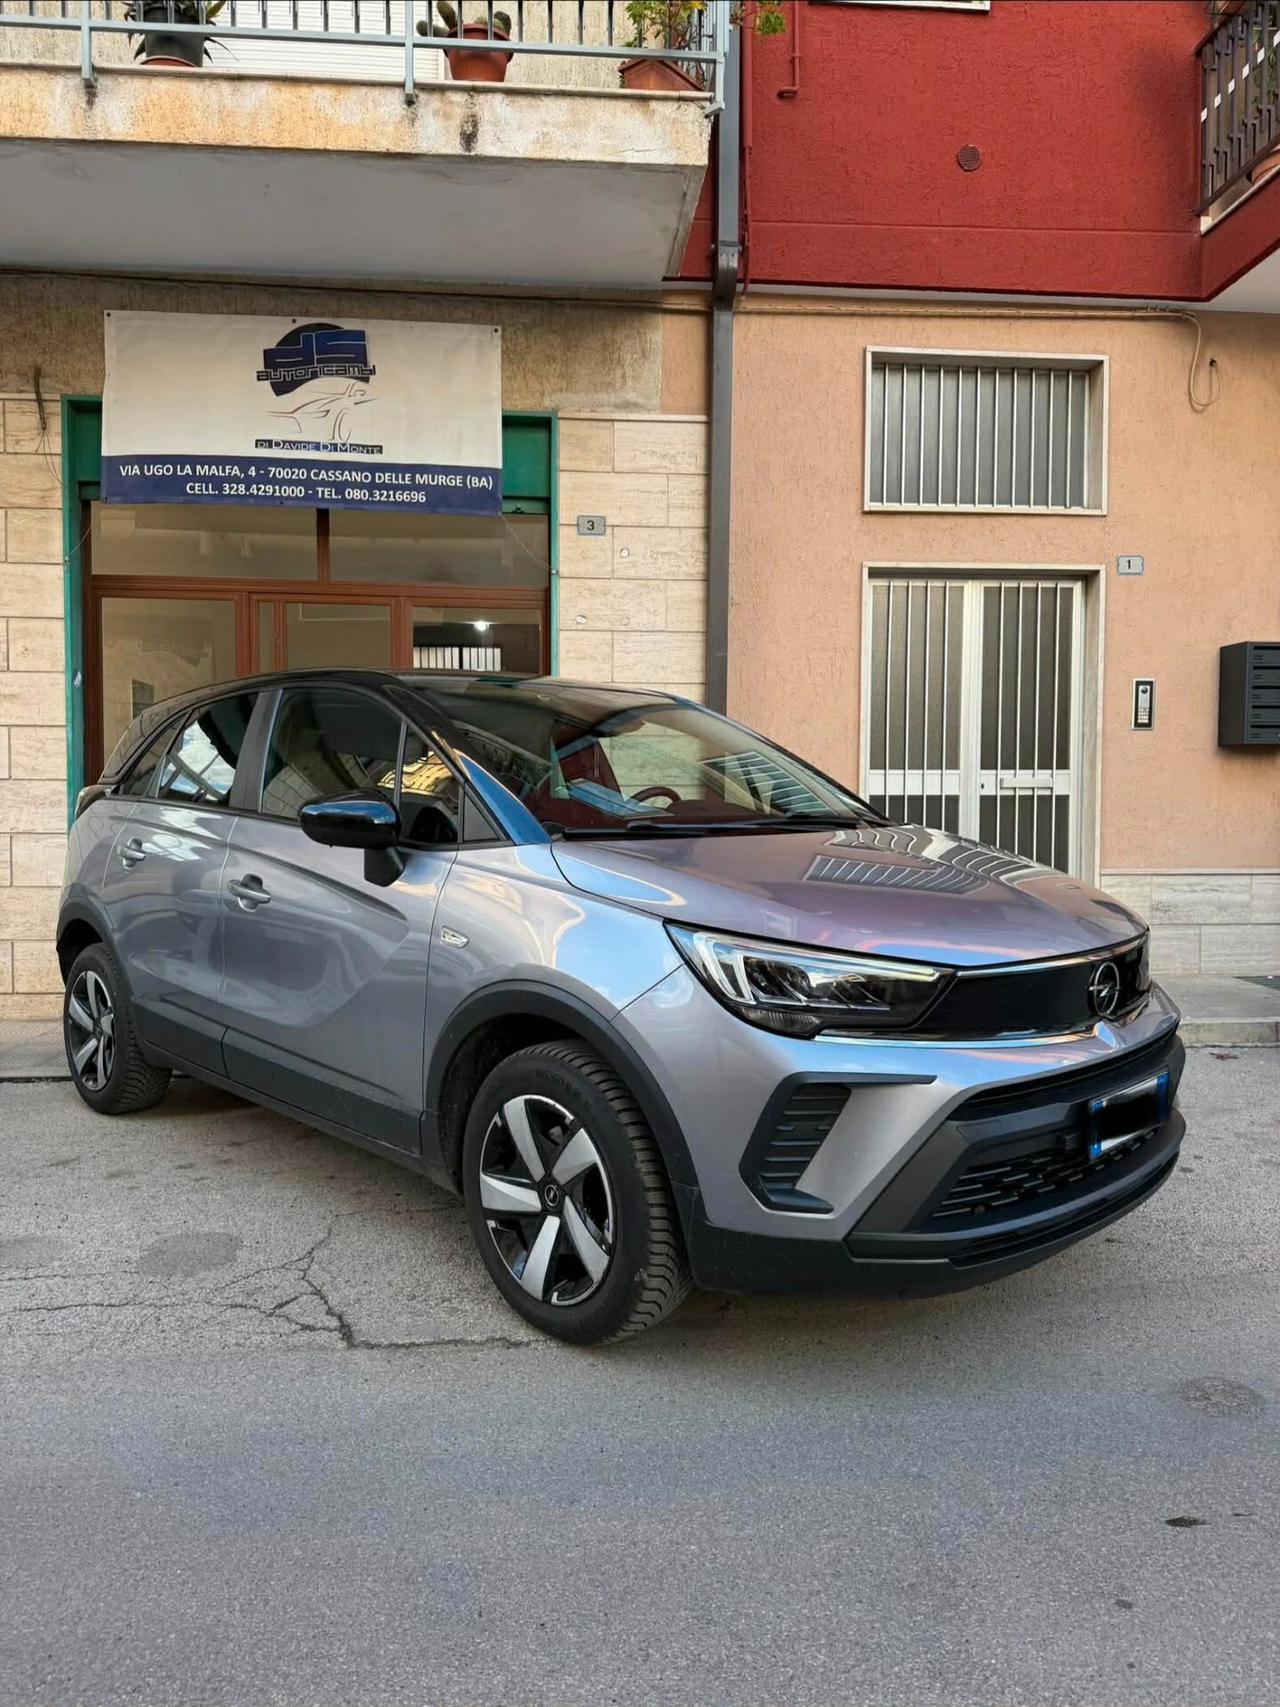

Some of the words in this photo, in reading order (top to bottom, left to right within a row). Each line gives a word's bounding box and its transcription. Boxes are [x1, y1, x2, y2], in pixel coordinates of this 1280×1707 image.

[120, 465, 140, 476] VIA
[144, 464, 173, 476] UGO
[177, 465, 192, 476] LA
[196, 465, 245, 479] MALFA,
[248, 466, 256, 477] 4
[268, 467, 307, 479] 70020
[310, 469, 372, 483] CASSANO
[375, 473, 412, 485] DELLE
[415, 474, 463, 487] MURGE
[466, 475, 493, 490] (BA)
[186, 482, 219, 494] CELL.
[222, 483, 305, 497] 328.4291000
[316, 487, 341, 499] TEL.
[344, 488, 426, 503] 080.3216696
[587, 520, 595, 531] 3
[1127, 559, 1131, 570] 1
